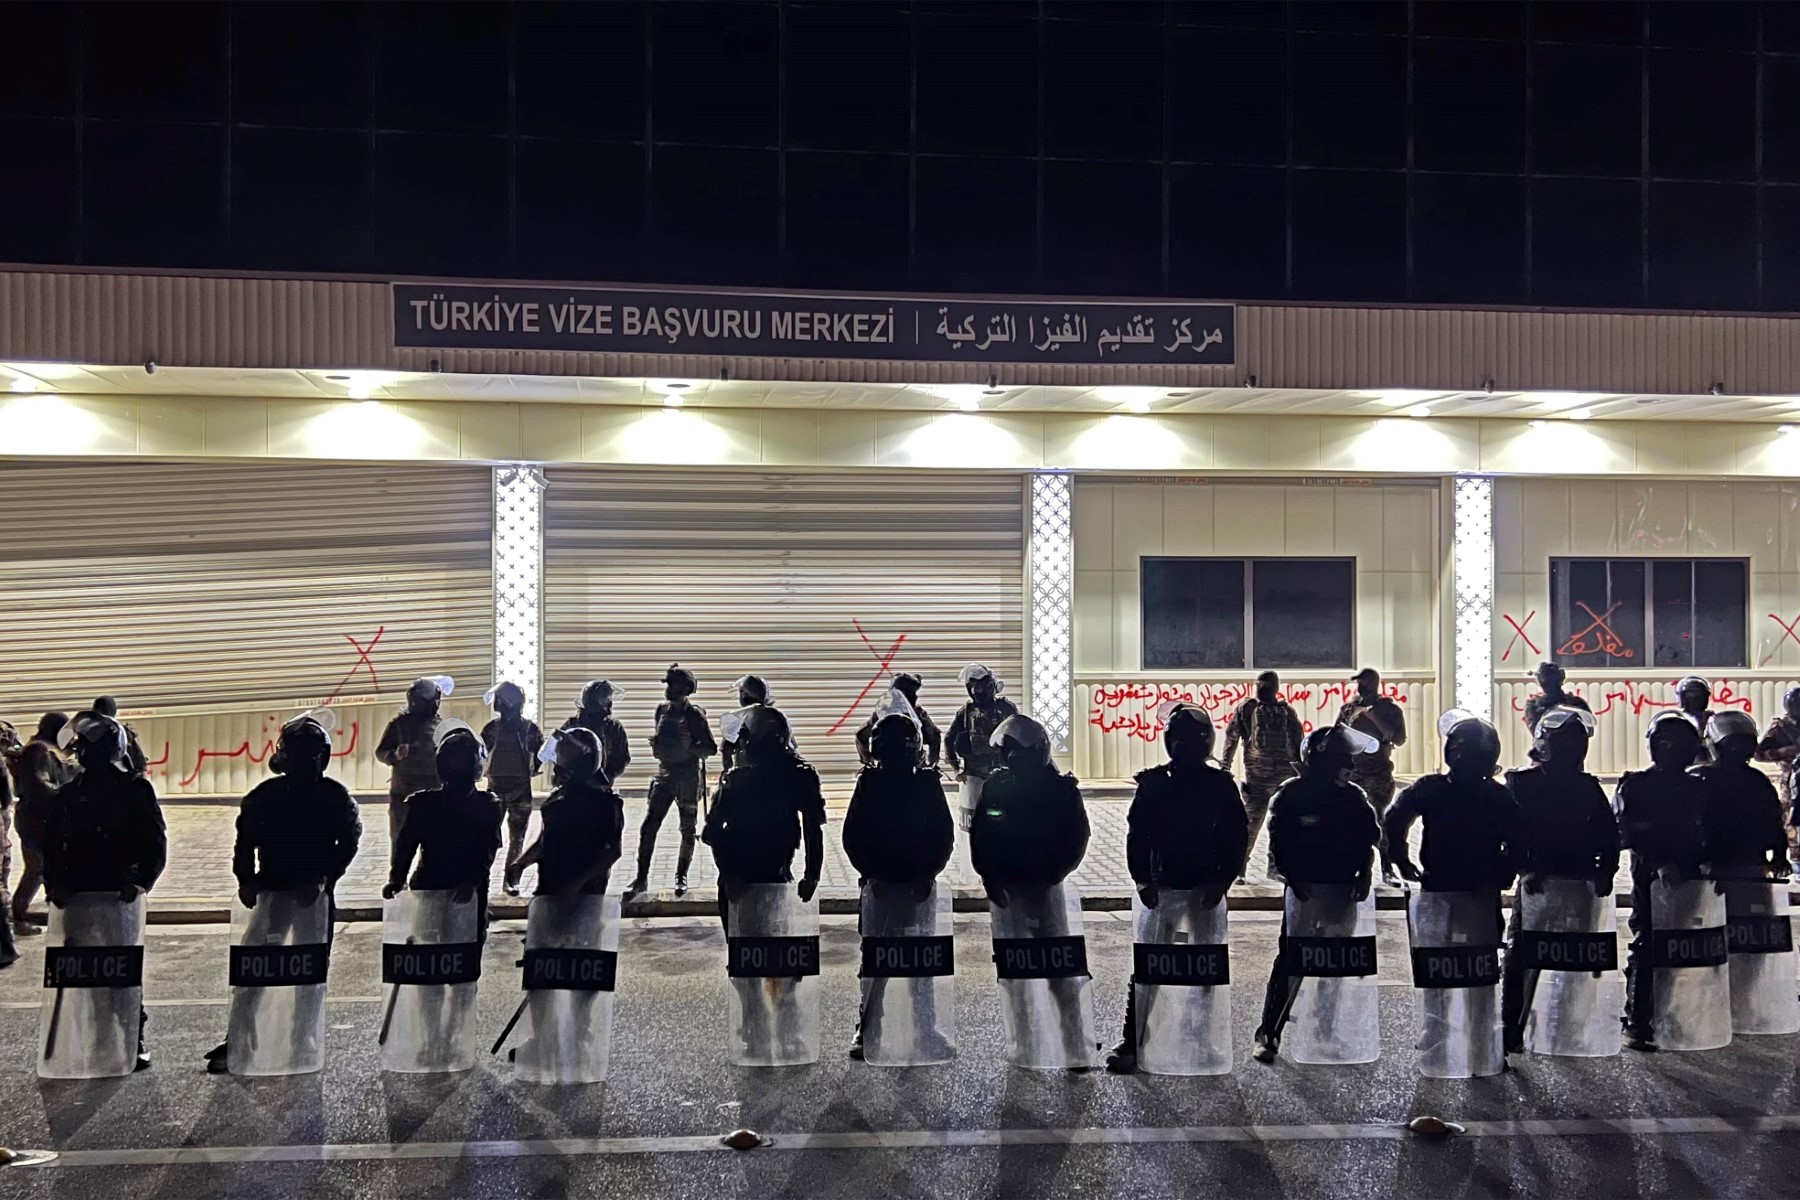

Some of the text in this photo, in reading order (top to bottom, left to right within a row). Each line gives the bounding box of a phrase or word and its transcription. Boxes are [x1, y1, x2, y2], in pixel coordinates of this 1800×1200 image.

[409, 294, 895, 344] TÜRKİYE VİZE BAŞVURU MERKEZİ
[936, 307, 1223, 357] مركز تقديم الفيزا التركية
[875, 944, 944, 969] POLICE
[1005, 945, 1075, 970] POLICE
[1301, 944, 1369, 969] POLICE
[1536, 940, 1609, 964] POLICE
[1666, 934, 1726, 960] POLICE
[54, 954, 129, 979] POLICE
[241, 953, 313, 978] POLICE
[392, 952, 465, 976] POLICE
[533, 957, 604, 981] POLICE
[1146, 952, 1219, 977] POLICE
[1428, 953, 1494, 980] POLICE
